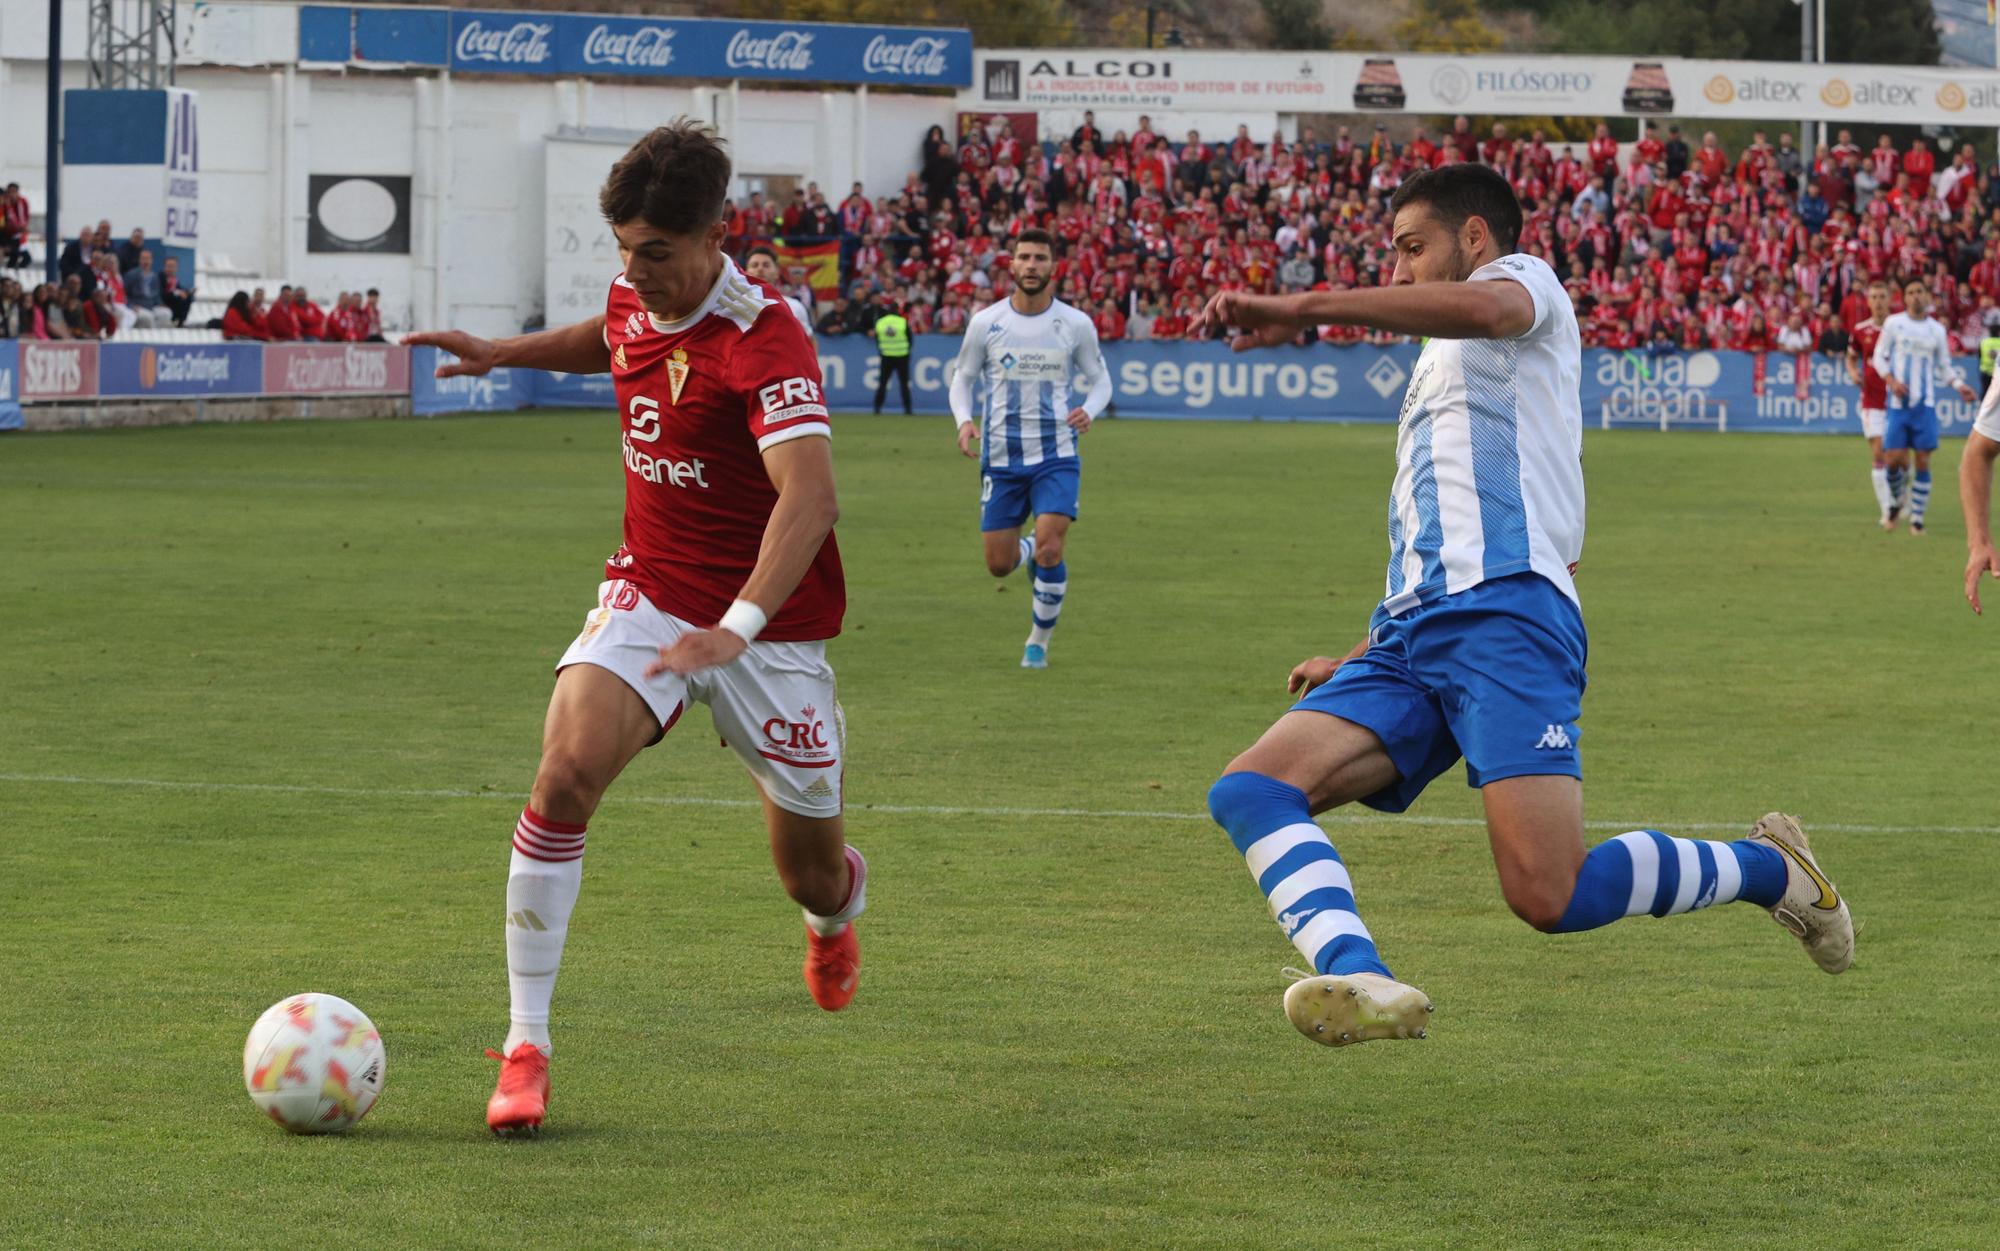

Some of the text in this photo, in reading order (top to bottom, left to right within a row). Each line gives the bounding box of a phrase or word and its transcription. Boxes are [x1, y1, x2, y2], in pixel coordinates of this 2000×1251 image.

[1029, 59, 1171, 78] ALCOI
[1476, 67, 1591, 92] FILÓSOFO
[1026, 80, 1324, 95] LA INDUSTRIA COMO MOTOR DE FUTURO
[1738, 77, 1801, 101] aitex
[1854, 80, 1918, 106] aitex
[1120, 358, 1340, 408] seguros
[1597, 352, 1685, 398] aqua
[1611, 384, 1706, 418] clean
[1756, 389, 1848, 425] limpia
[762, 717, 828, 750] CRC
